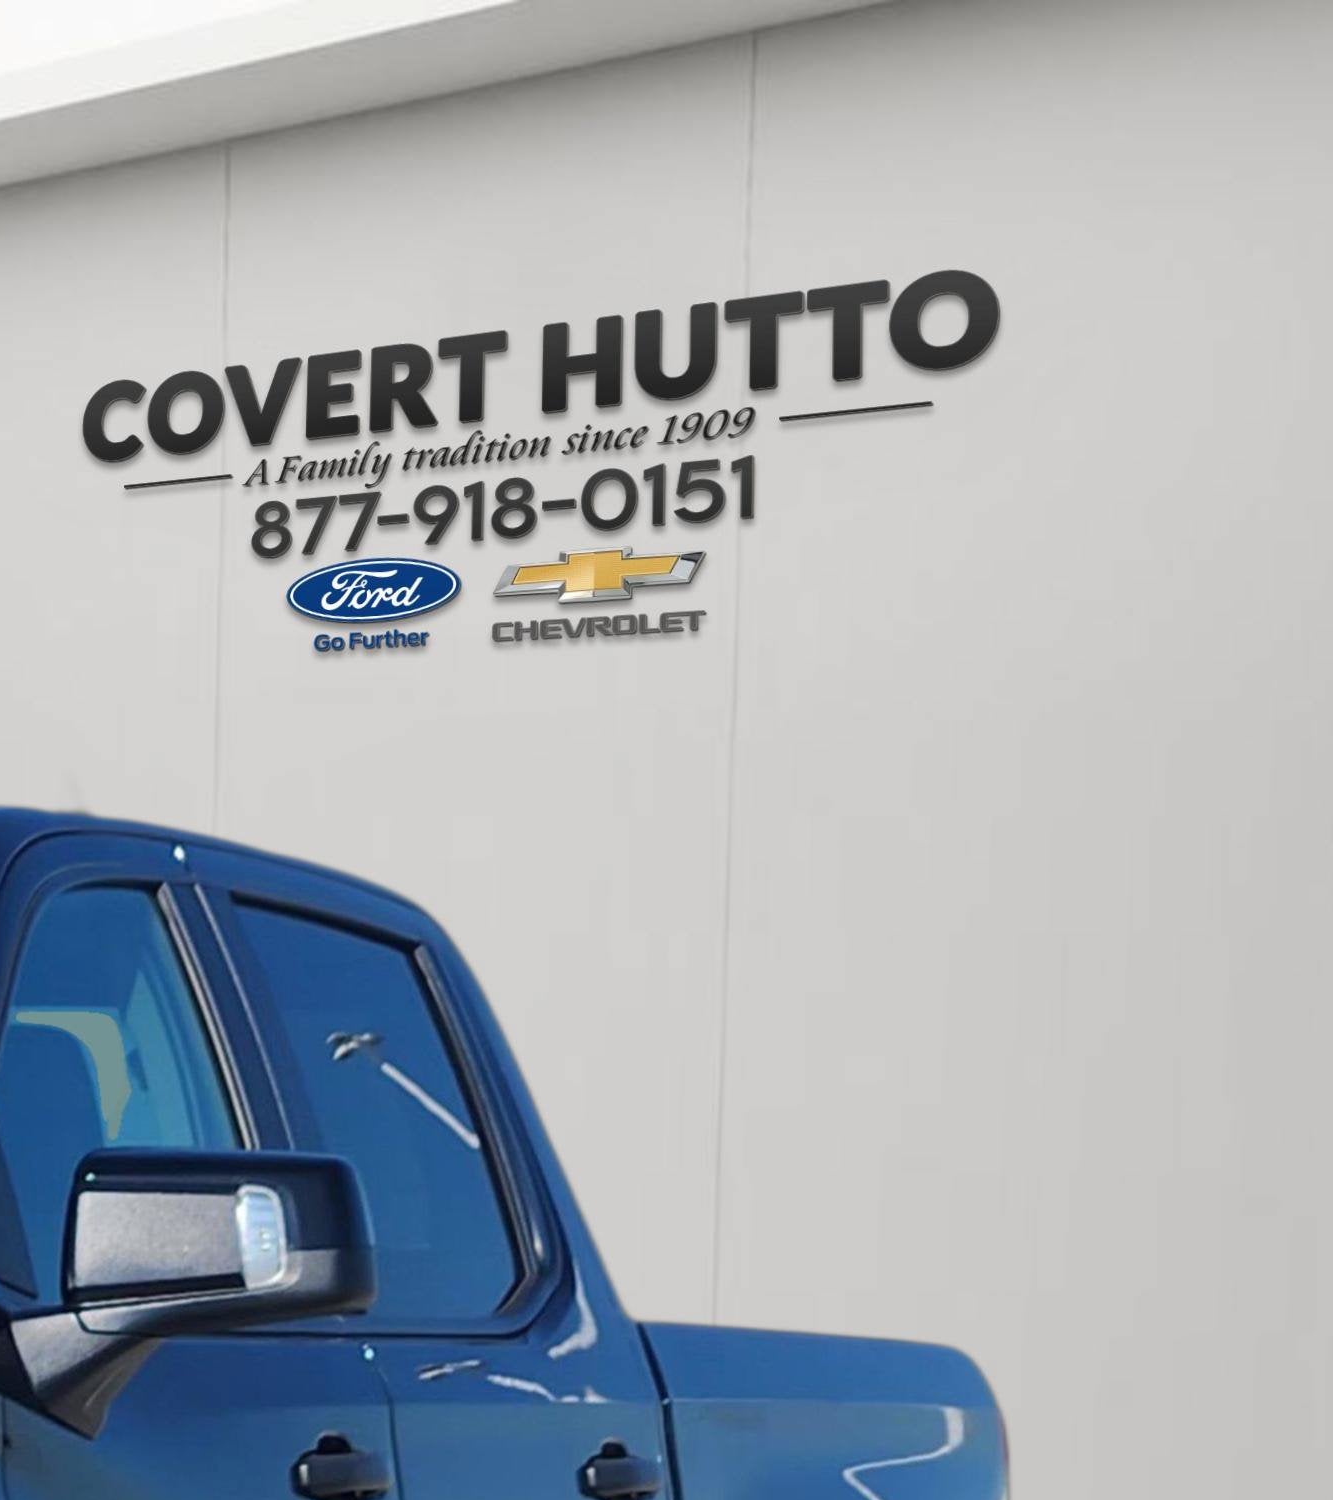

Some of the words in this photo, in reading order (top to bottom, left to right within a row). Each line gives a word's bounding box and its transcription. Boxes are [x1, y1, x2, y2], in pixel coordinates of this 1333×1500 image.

[82, 330, 508, 463] COVERT
[540, 268, 1001, 413] HUTTO
[243, 458, 270, 488] A
[276, 441, 392, 488] Family
[403, 429, 552, 472] tradition
[561, 423, 649, 455] since
[656, 406, 756, 447] 1909
[250, 454, 756, 559] 877-918-0151
[320, 568, 421, 611] Ford
[313, 633, 346, 653] Go
[348, 628, 430, 651] Further
[491, 609, 708, 643] CHEVROLET
